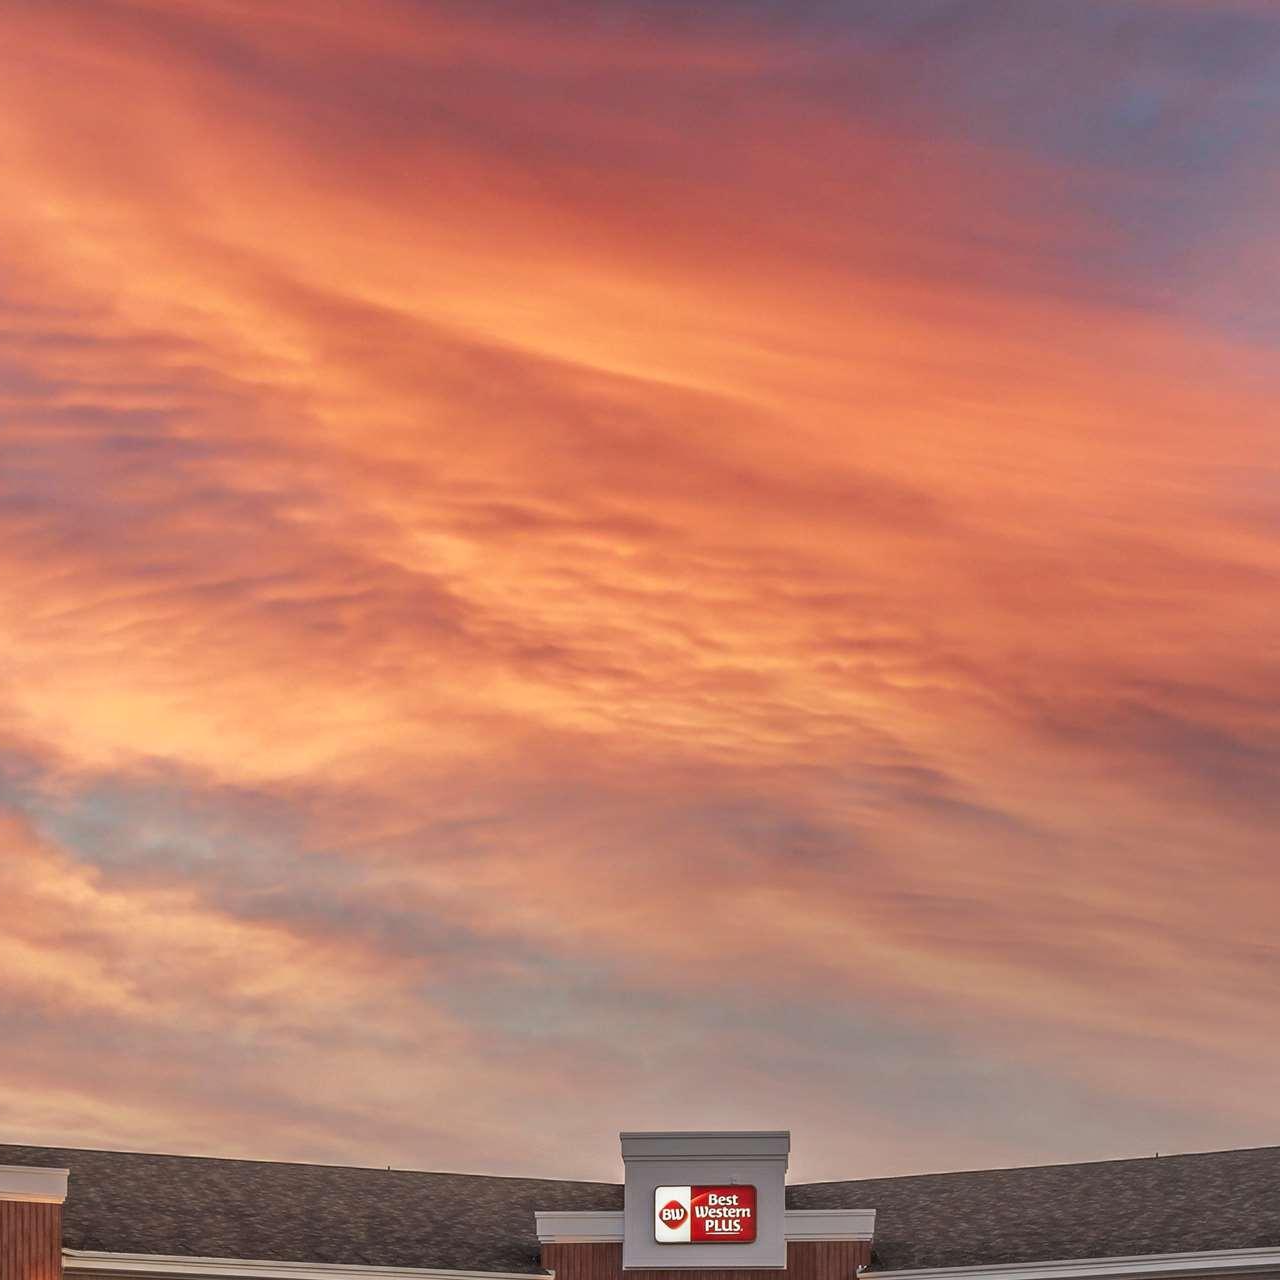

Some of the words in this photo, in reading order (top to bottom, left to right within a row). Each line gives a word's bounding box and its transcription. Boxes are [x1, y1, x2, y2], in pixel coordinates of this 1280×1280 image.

[708, 1193, 739, 1206] Best
[662, 1208, 685, 1221] BW
[694, 1206, 751, 1218] Western
